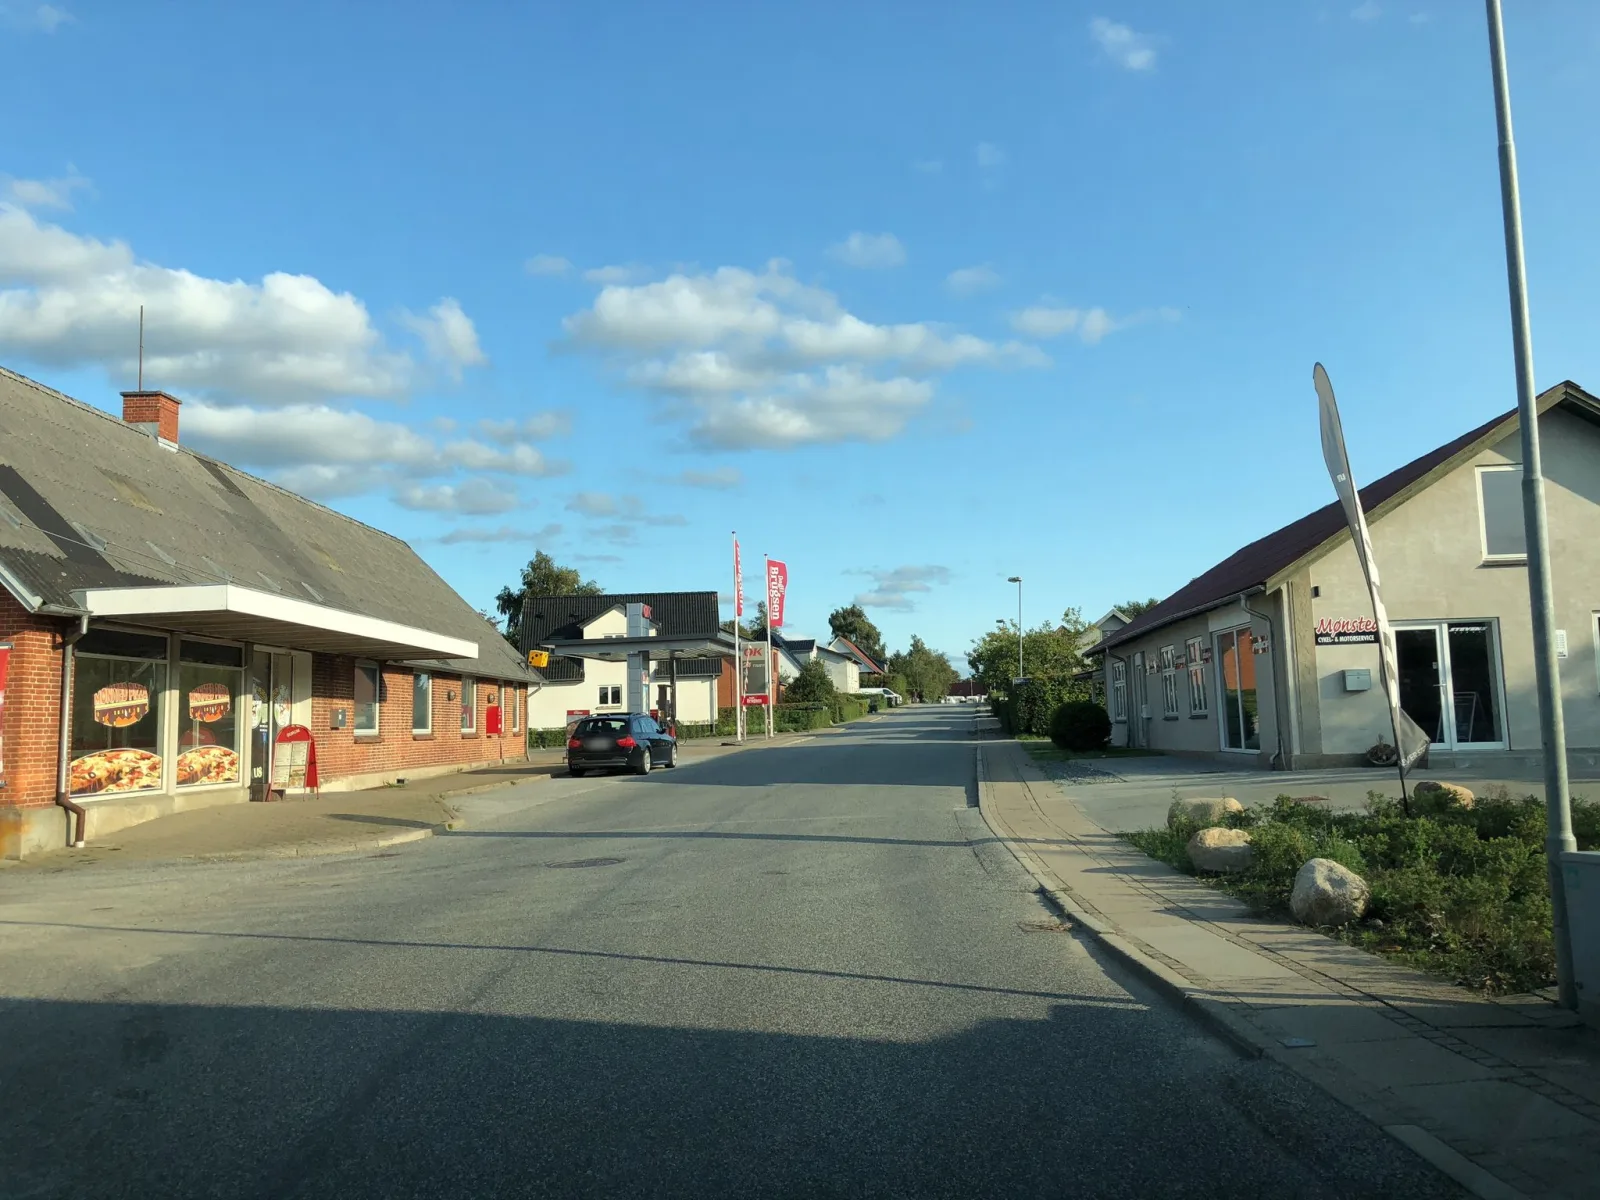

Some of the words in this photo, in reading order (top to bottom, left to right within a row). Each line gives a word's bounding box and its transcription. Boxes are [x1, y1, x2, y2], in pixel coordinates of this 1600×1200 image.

[769, 566, 781, 621] Brugsen
[1339, 634, 1375, 642] MOTORSERVICE
[743, 647, 762, 656] OK
